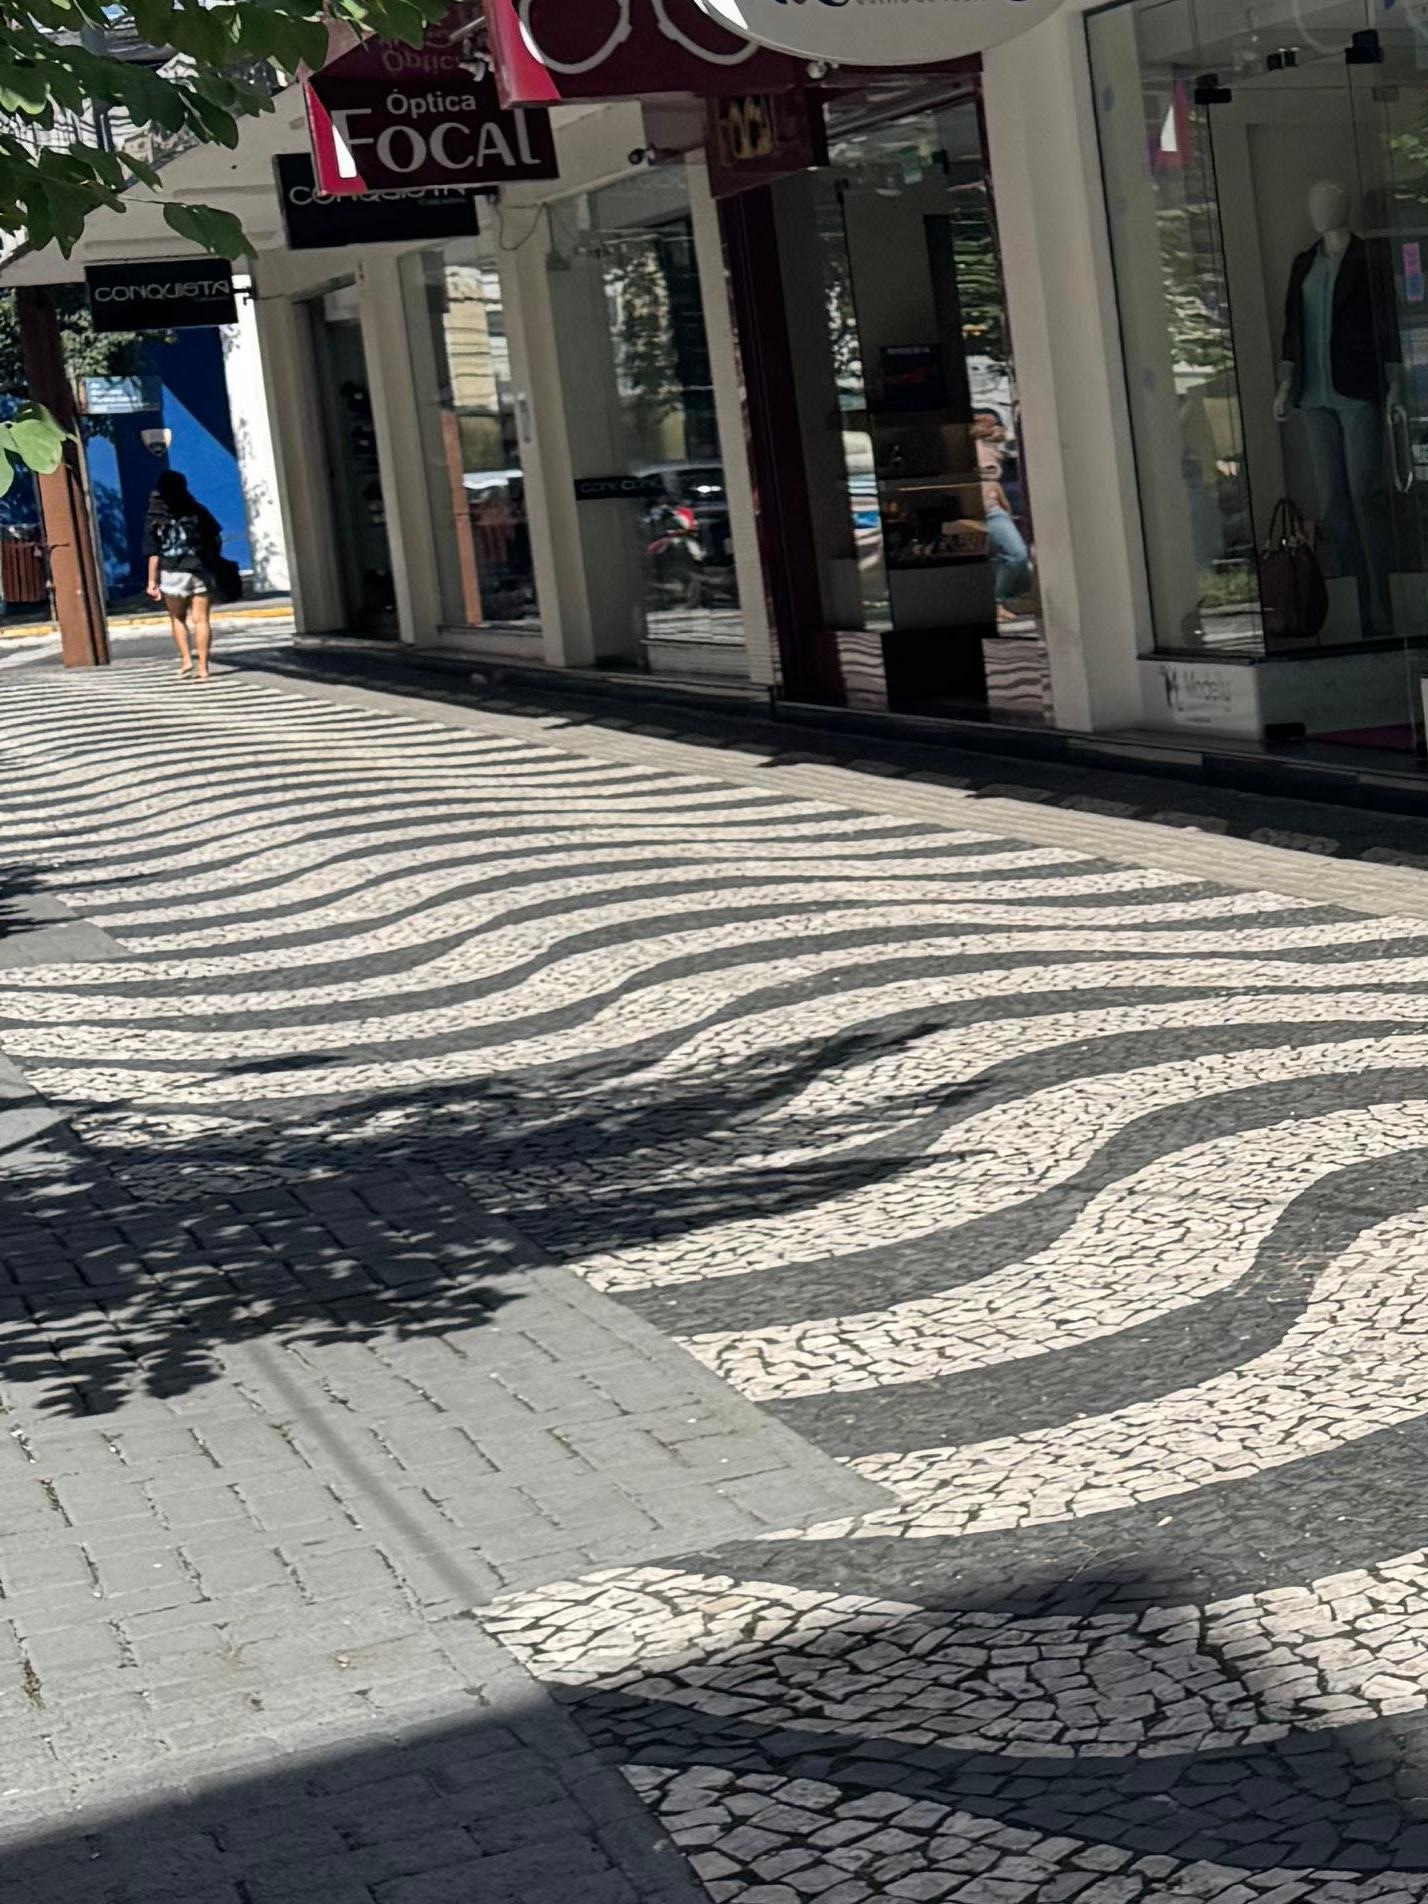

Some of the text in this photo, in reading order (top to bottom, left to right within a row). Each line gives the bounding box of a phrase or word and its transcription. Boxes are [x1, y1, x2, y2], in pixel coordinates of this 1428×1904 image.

[386, 89, 477, 119] Óptica
[330, 107, 541, 173] FOCAL
[94, 278, 230, 302] CONQUISTA
